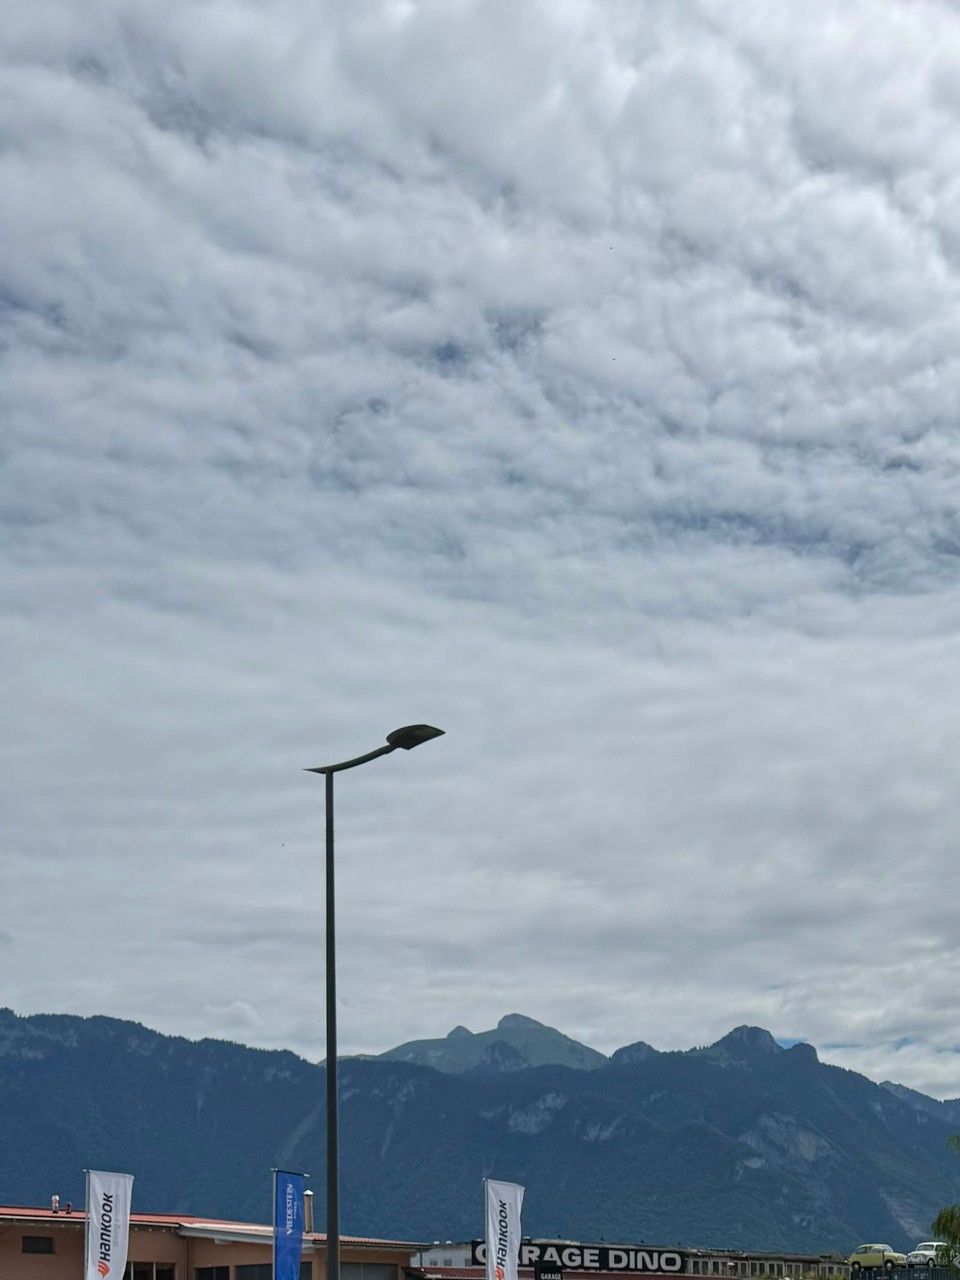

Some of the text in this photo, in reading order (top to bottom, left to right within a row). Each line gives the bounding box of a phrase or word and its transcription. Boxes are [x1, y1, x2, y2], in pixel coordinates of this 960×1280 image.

[475, 1243, 682, 1271] GRAGE DINO
[540, 1272, 562, 1280] GARAGE
